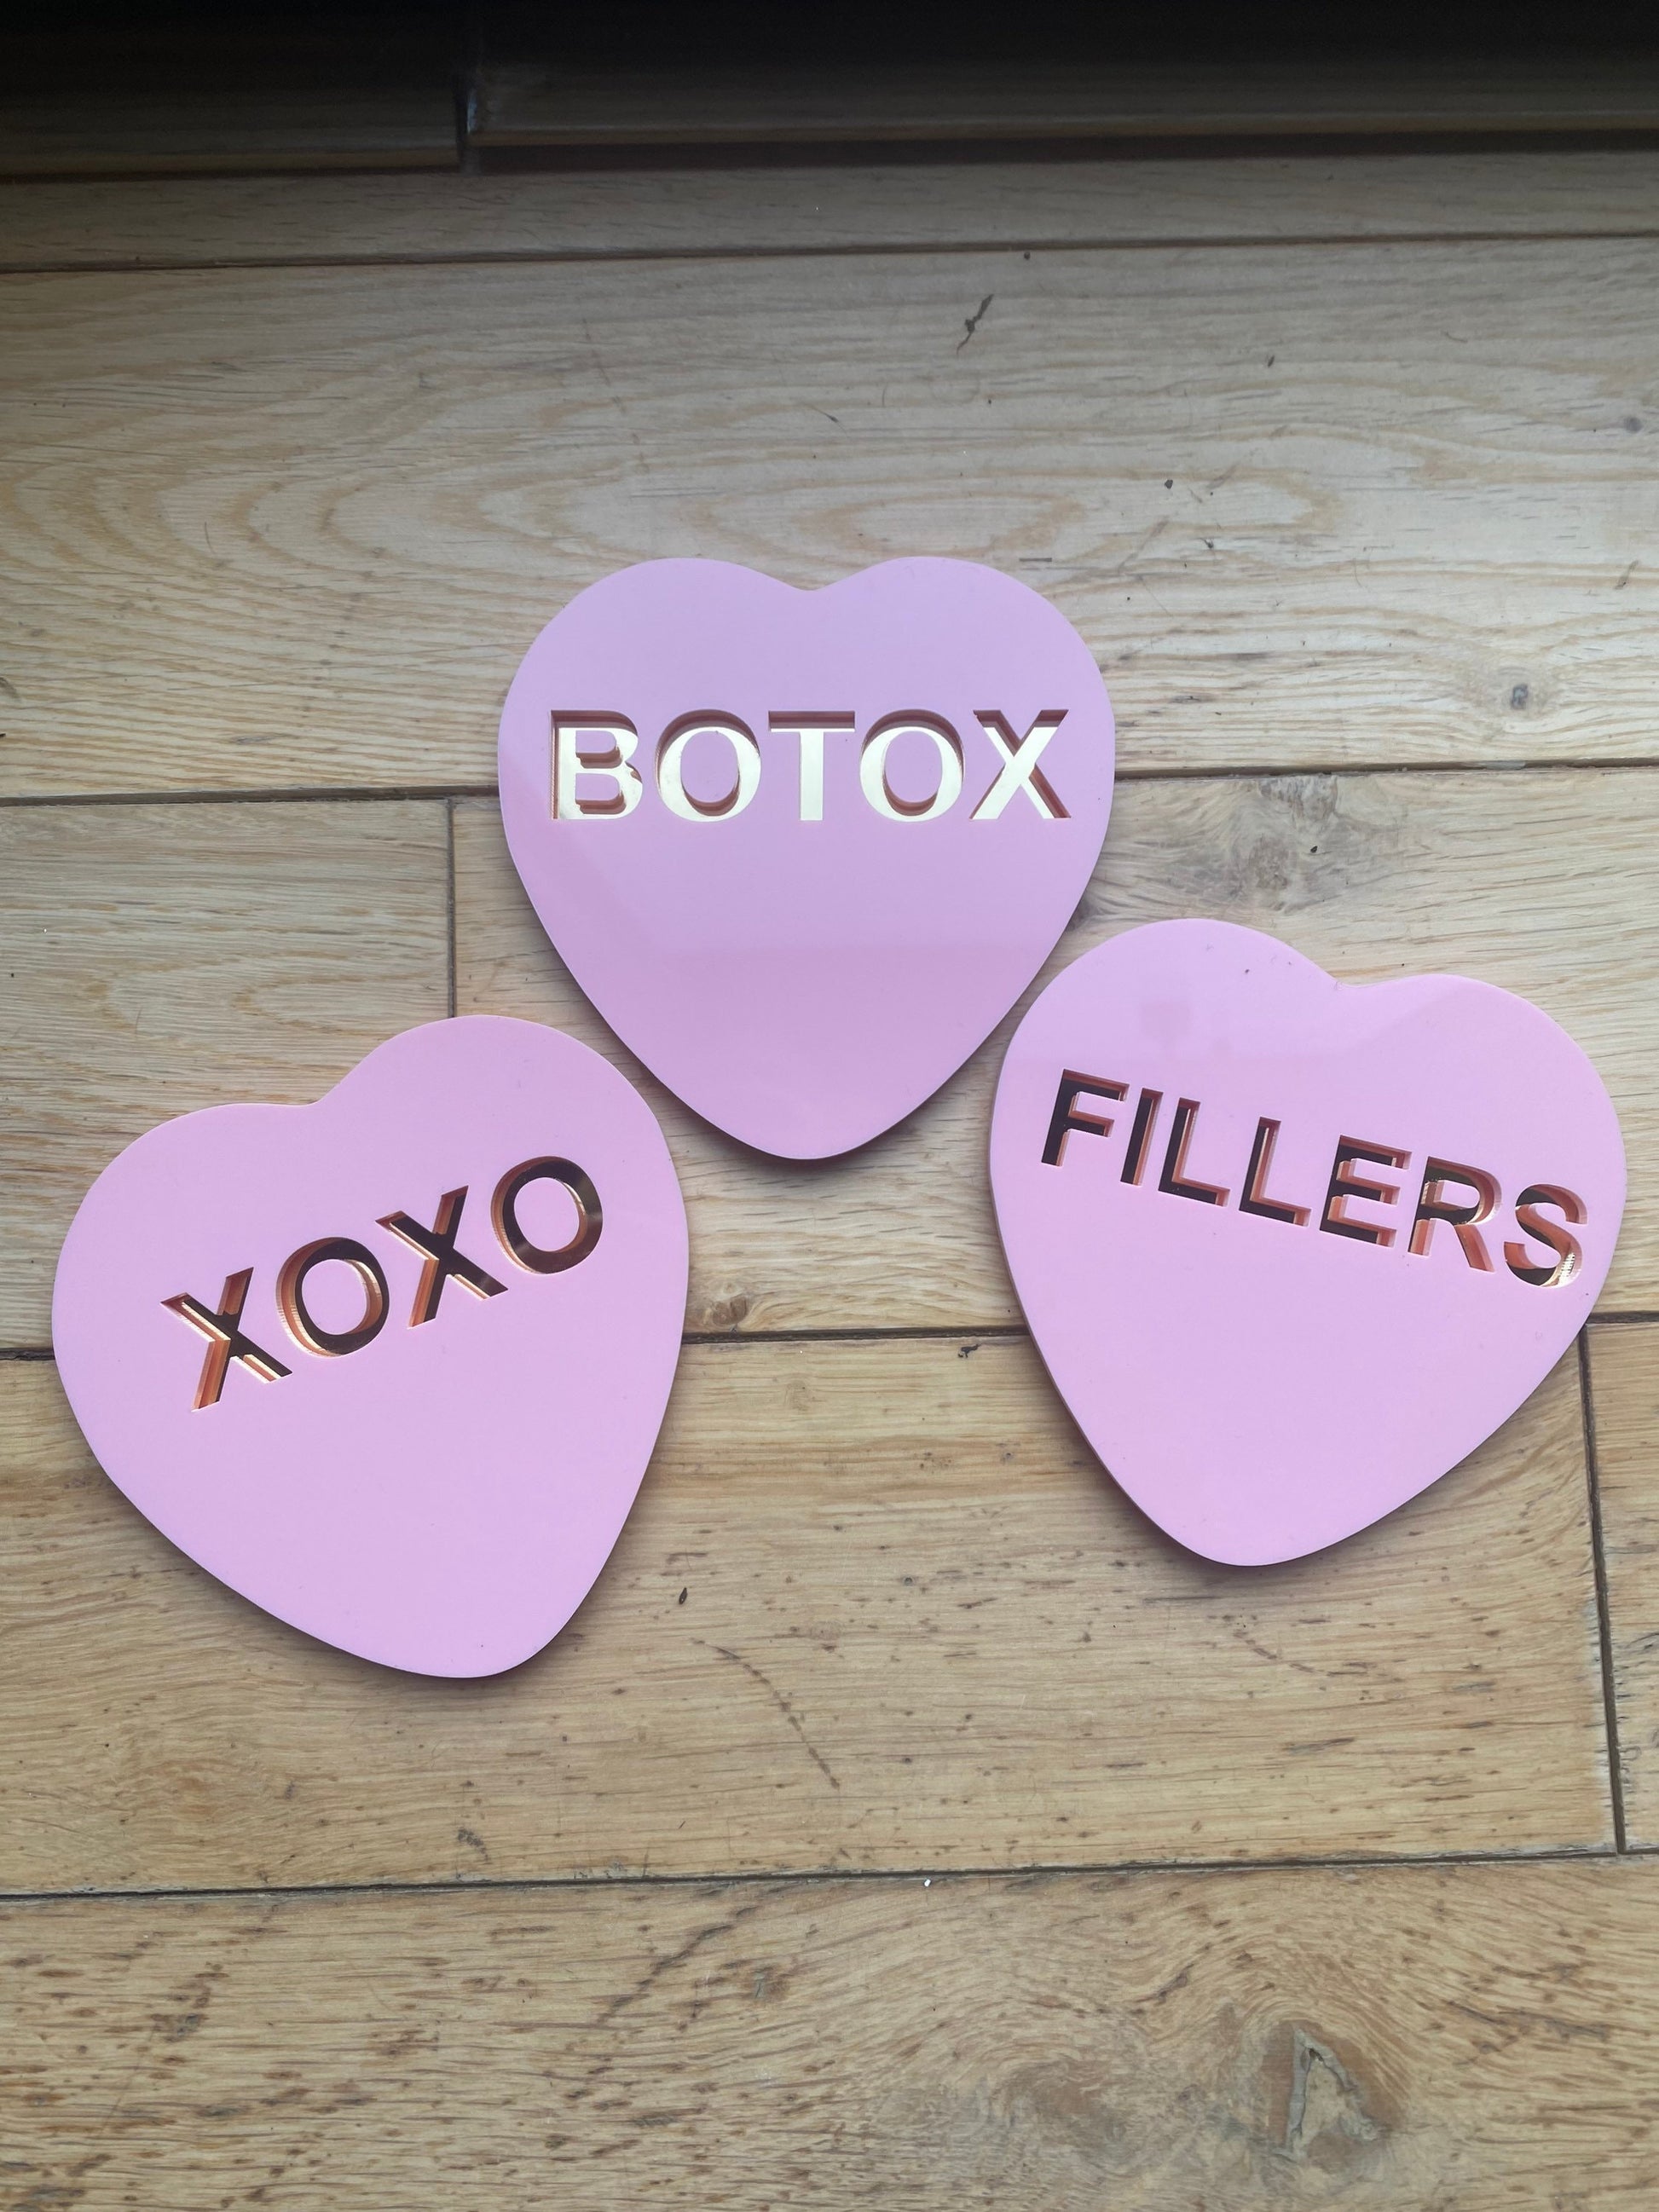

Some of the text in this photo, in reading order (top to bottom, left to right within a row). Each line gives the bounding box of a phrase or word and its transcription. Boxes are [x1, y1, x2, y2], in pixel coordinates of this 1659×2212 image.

[550, 709, 1072, 823] BOTOX
[160, 1156, 604, 1412] XOXO
[1041, 1069, 1587, 1288] FILLERS
